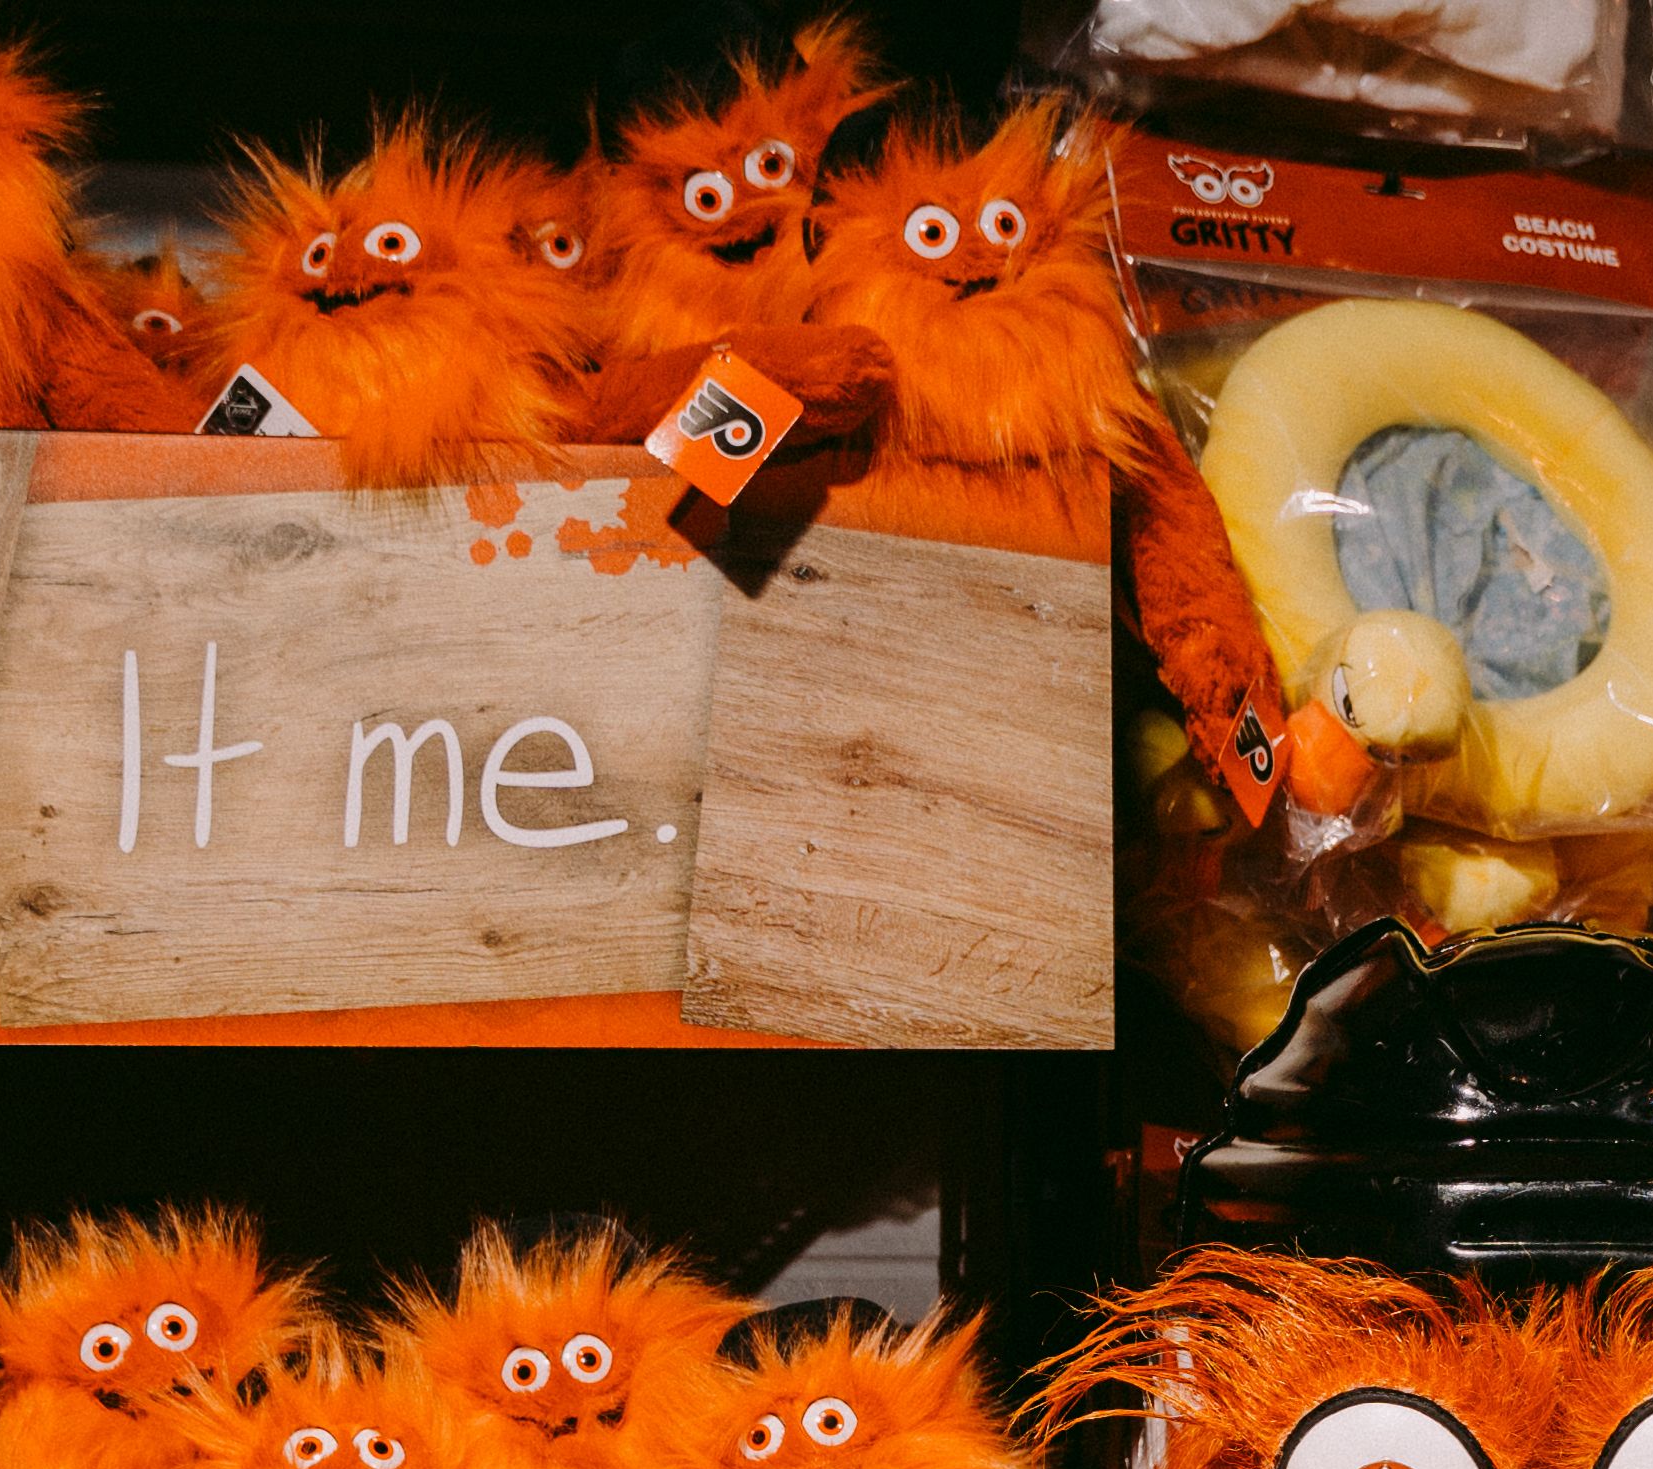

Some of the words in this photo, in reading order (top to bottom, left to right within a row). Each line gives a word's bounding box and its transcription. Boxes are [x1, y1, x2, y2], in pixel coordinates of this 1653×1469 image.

[1170, 217, 1296, 254] GRITTY
[1513, 213, 1596, 241] BEACH
[1502, 233, 1621, 267] COSTUME
[118, 642, 263, 854] It
[343, 714, 678, 849] me.
